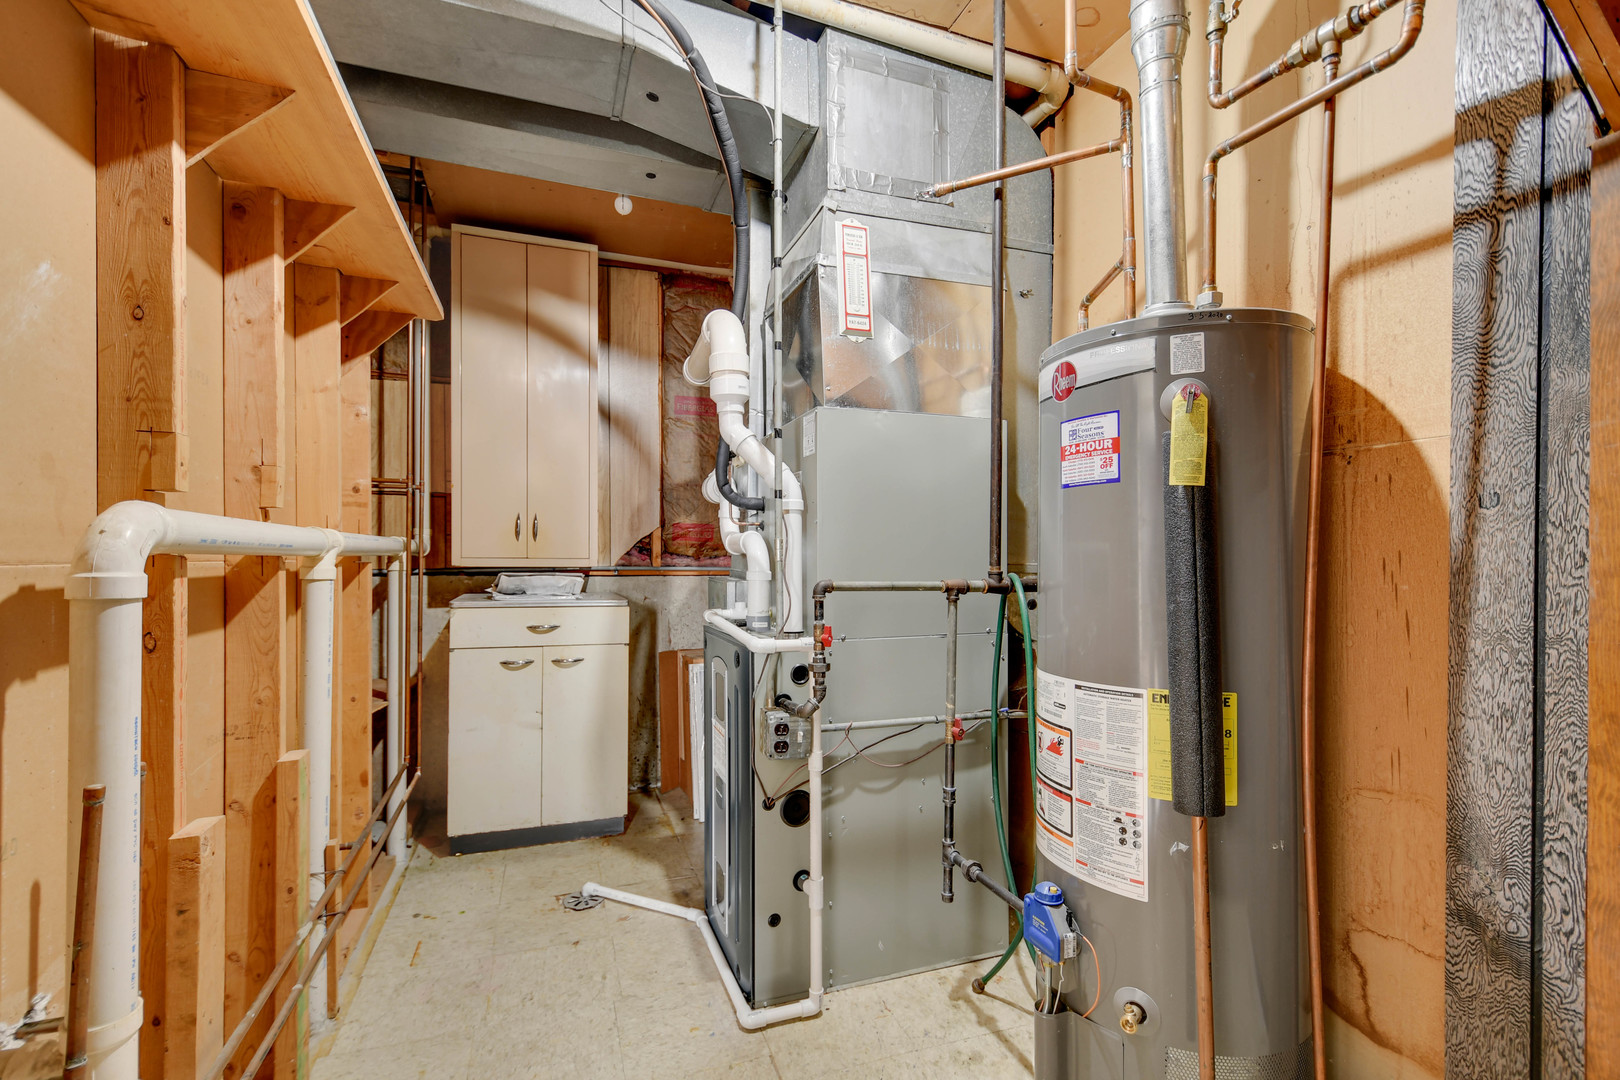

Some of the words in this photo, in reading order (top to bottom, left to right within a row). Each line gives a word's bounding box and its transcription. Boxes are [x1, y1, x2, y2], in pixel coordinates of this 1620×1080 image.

[1089, 342, 1152, 359] PRESSIONAL
[1052, 362, 1076, 397] Rheem
[1077, 431, 1105, 439] Seasons
[1065, 439, 1113, 455] 24-HOUR
[1224, 729, 1232, 739] 8
